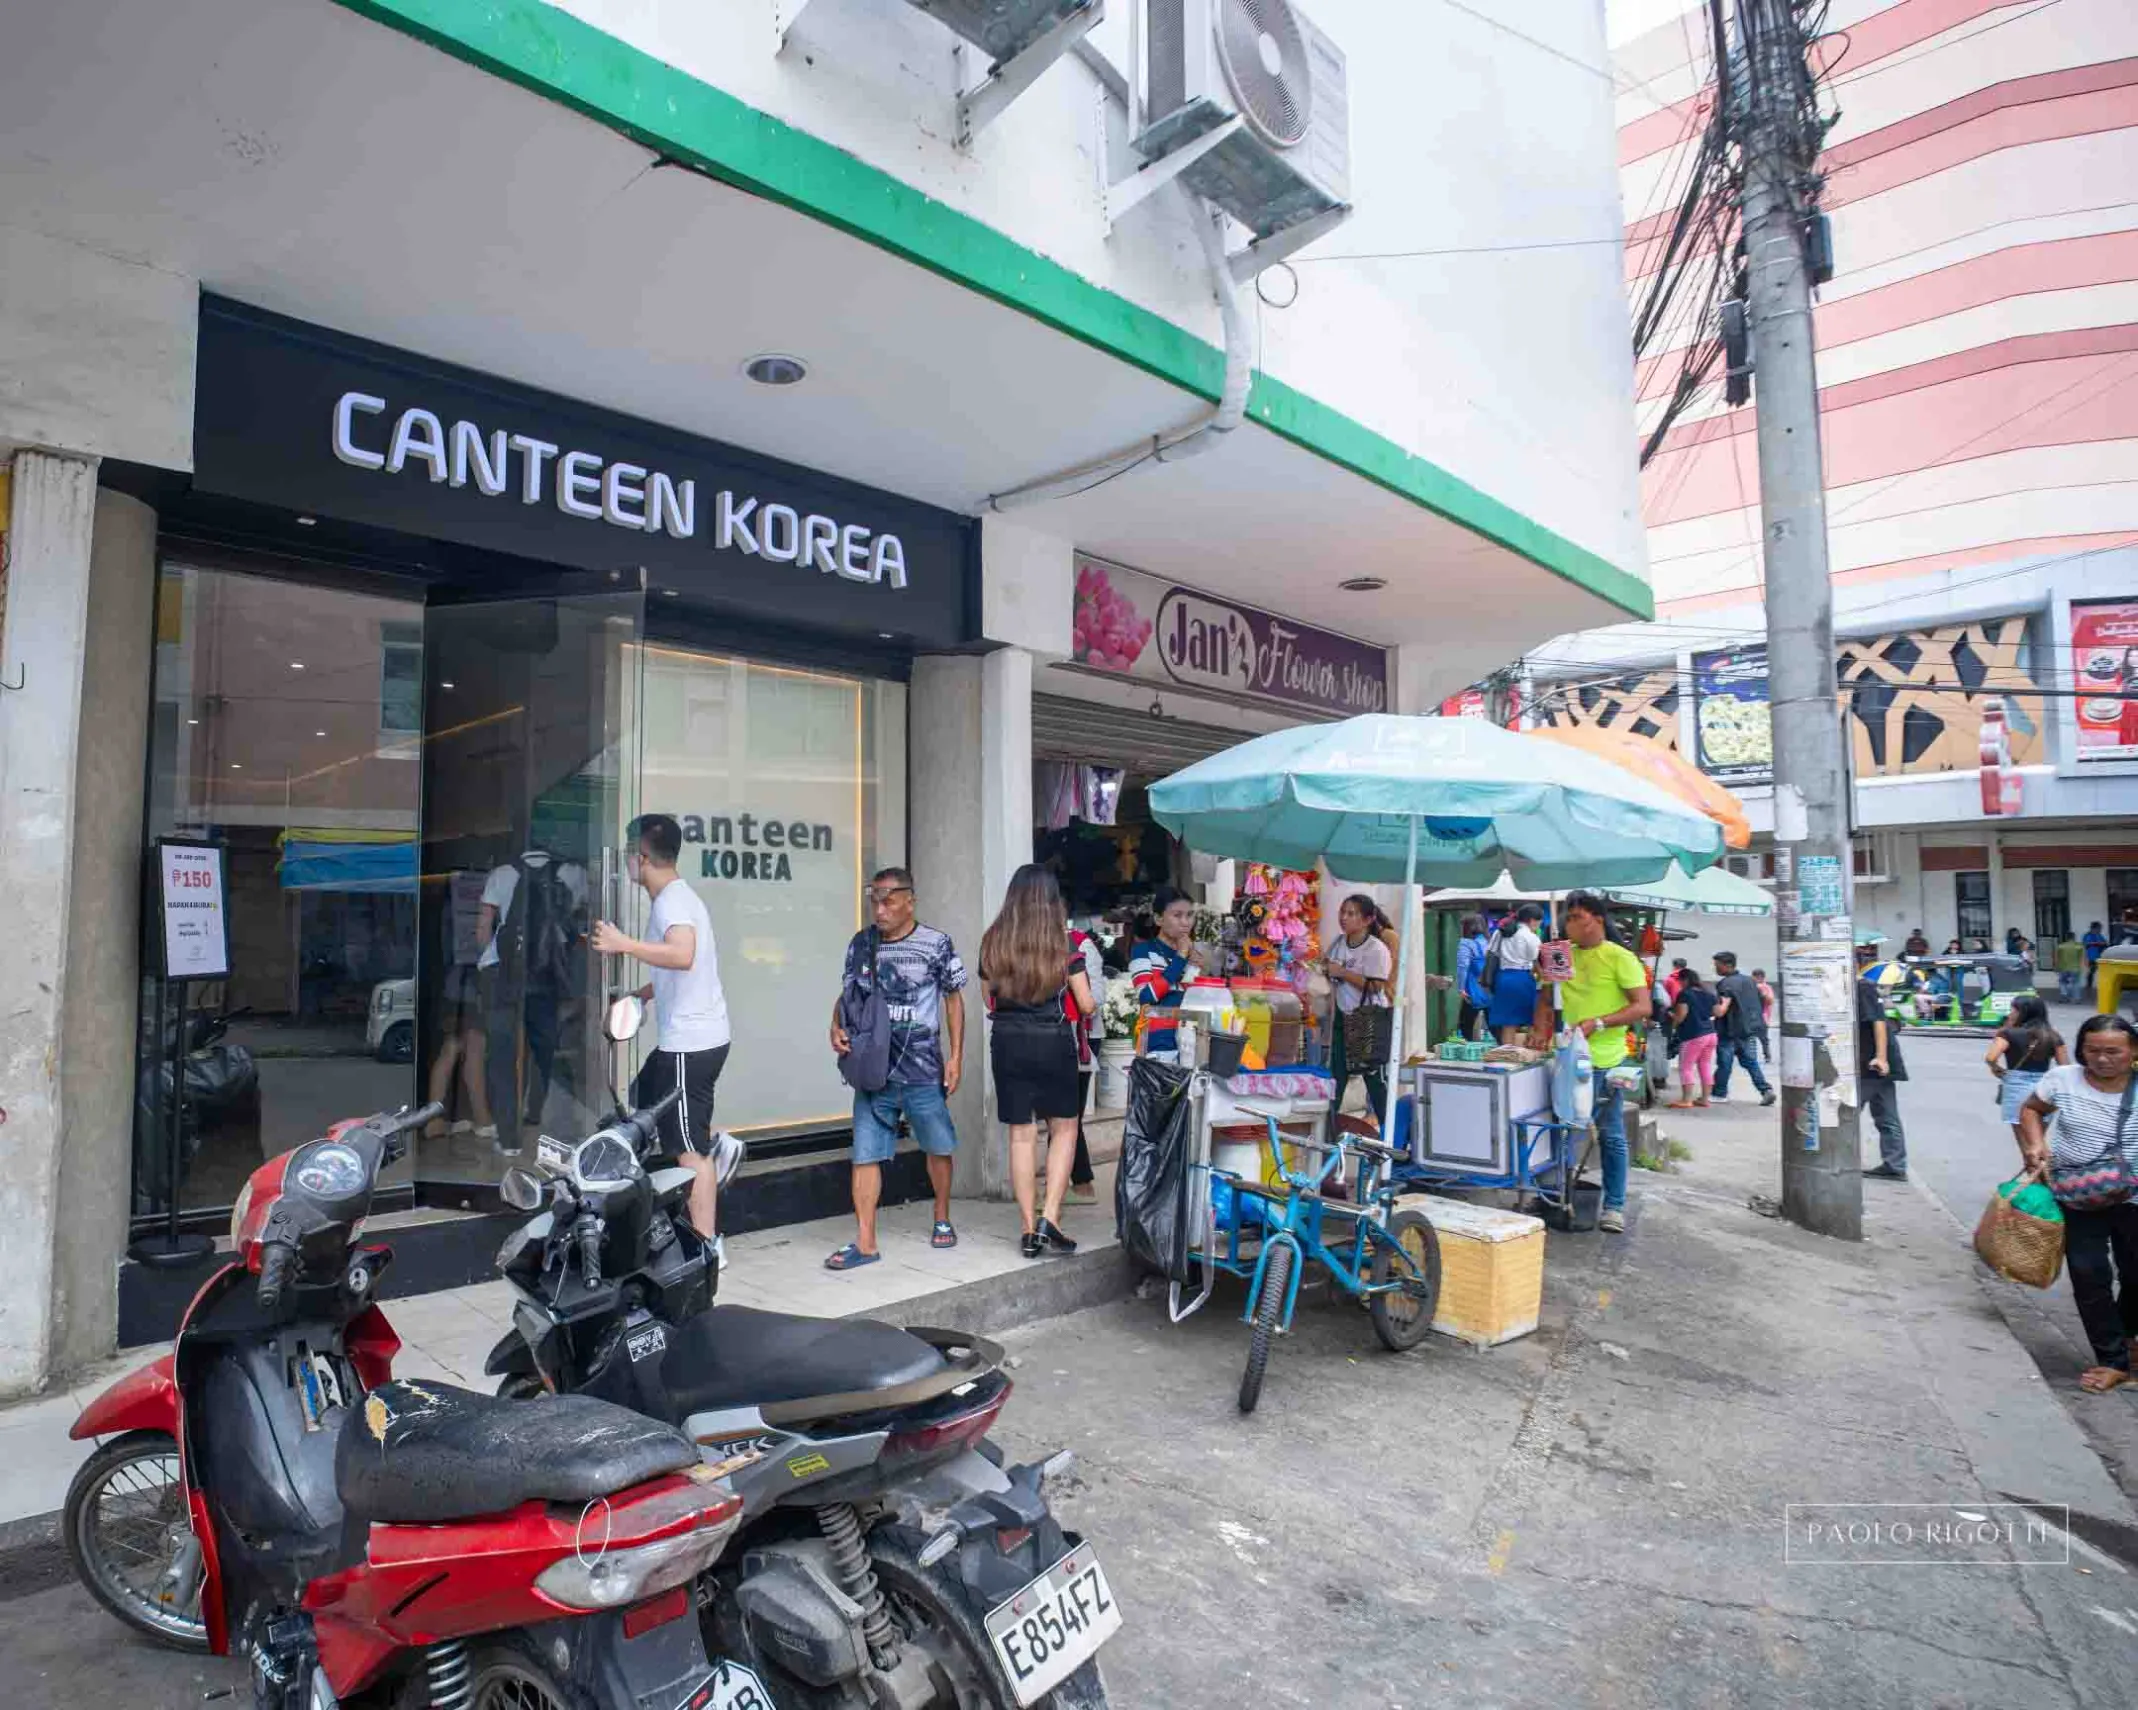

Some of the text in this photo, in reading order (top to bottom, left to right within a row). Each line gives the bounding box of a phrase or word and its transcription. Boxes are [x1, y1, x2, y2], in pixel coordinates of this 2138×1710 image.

[333, 392, 908, 590] CANTEEN KOREA
[673, 812, 833, 851] anteen
[700, 849, 793, 882] KOREA
[1001, 1567, 1110, 1682] E854FZ
